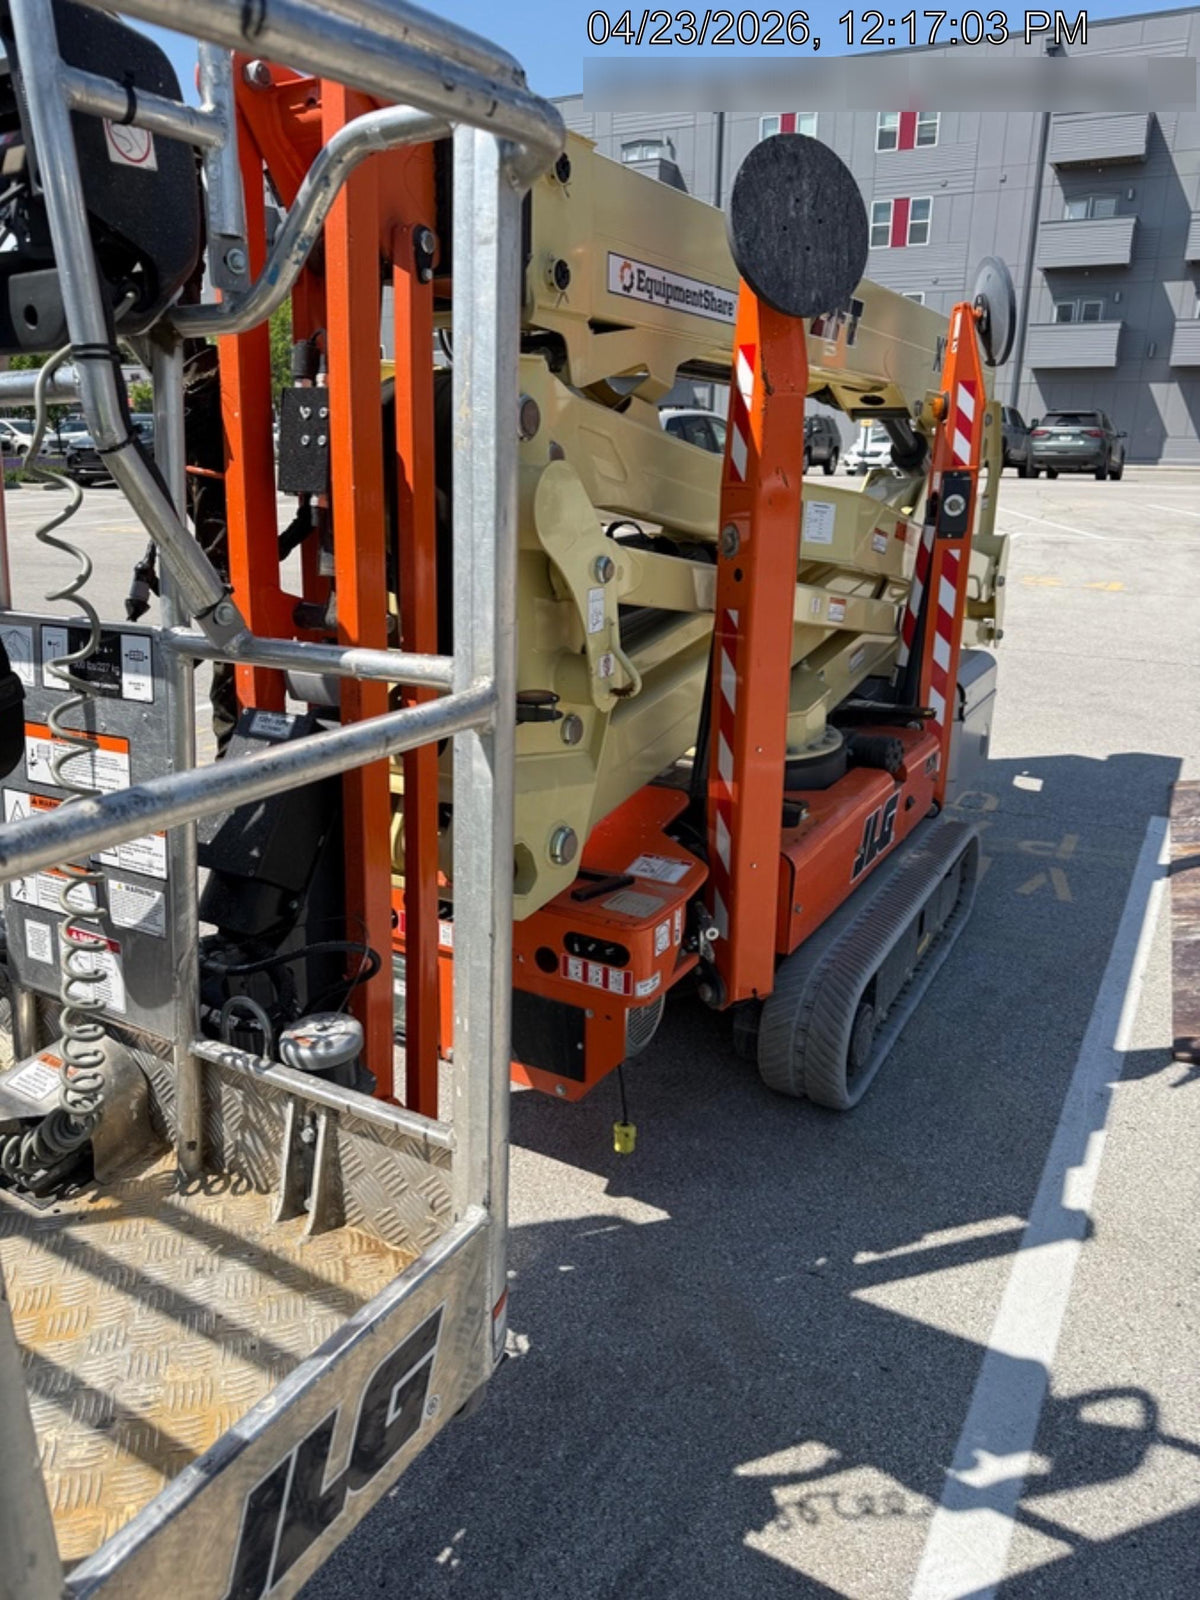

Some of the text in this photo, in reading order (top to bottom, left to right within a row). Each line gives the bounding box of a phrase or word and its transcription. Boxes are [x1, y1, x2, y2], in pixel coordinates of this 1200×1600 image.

[635, 268, 735, 317] EquipmentShare
[850, 789, 902, 884] JLG
[222, 1301, 447, 1600] JLG
